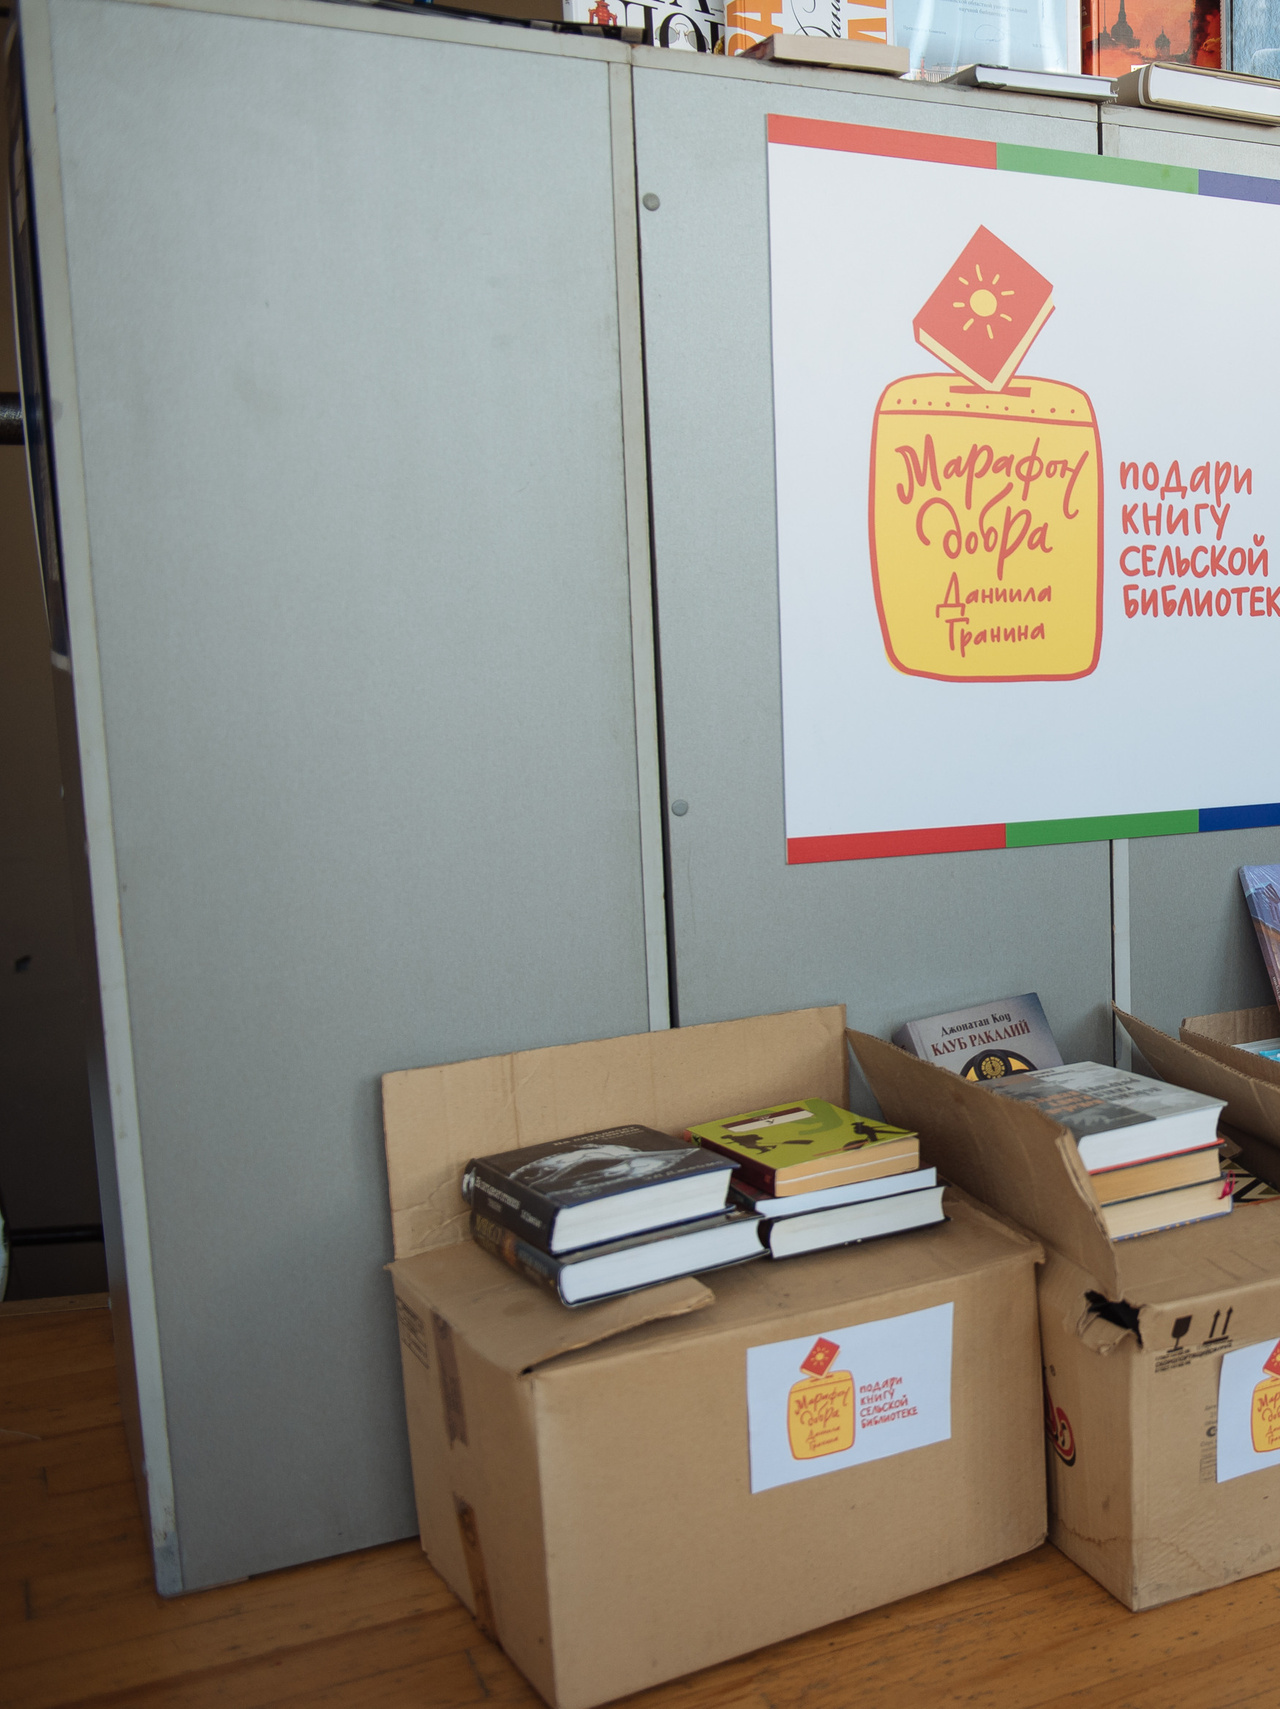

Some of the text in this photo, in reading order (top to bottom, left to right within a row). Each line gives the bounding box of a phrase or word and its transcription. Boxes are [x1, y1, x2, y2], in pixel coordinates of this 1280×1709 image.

[895, 434, 1089, 519] Марафон
[1122, 503, 1230, 540] КНИГУ
[1119, 534, 1269, 578] СЕЛЬСКОЙ
[936, 572, 1052, 617] Даниила
[945, 617, 1045, 657] Гранина
[930, 1019, 1031, 1057] КЛУБ РАКАЛИЙ
[941, 1012, 1012, 1037] Джонатан Коу
[860, 1394, 908, 1418] СЕЛЬСКОЙ
[861, 1406, 918, 1429] БИБЛИОТЕКЕ
